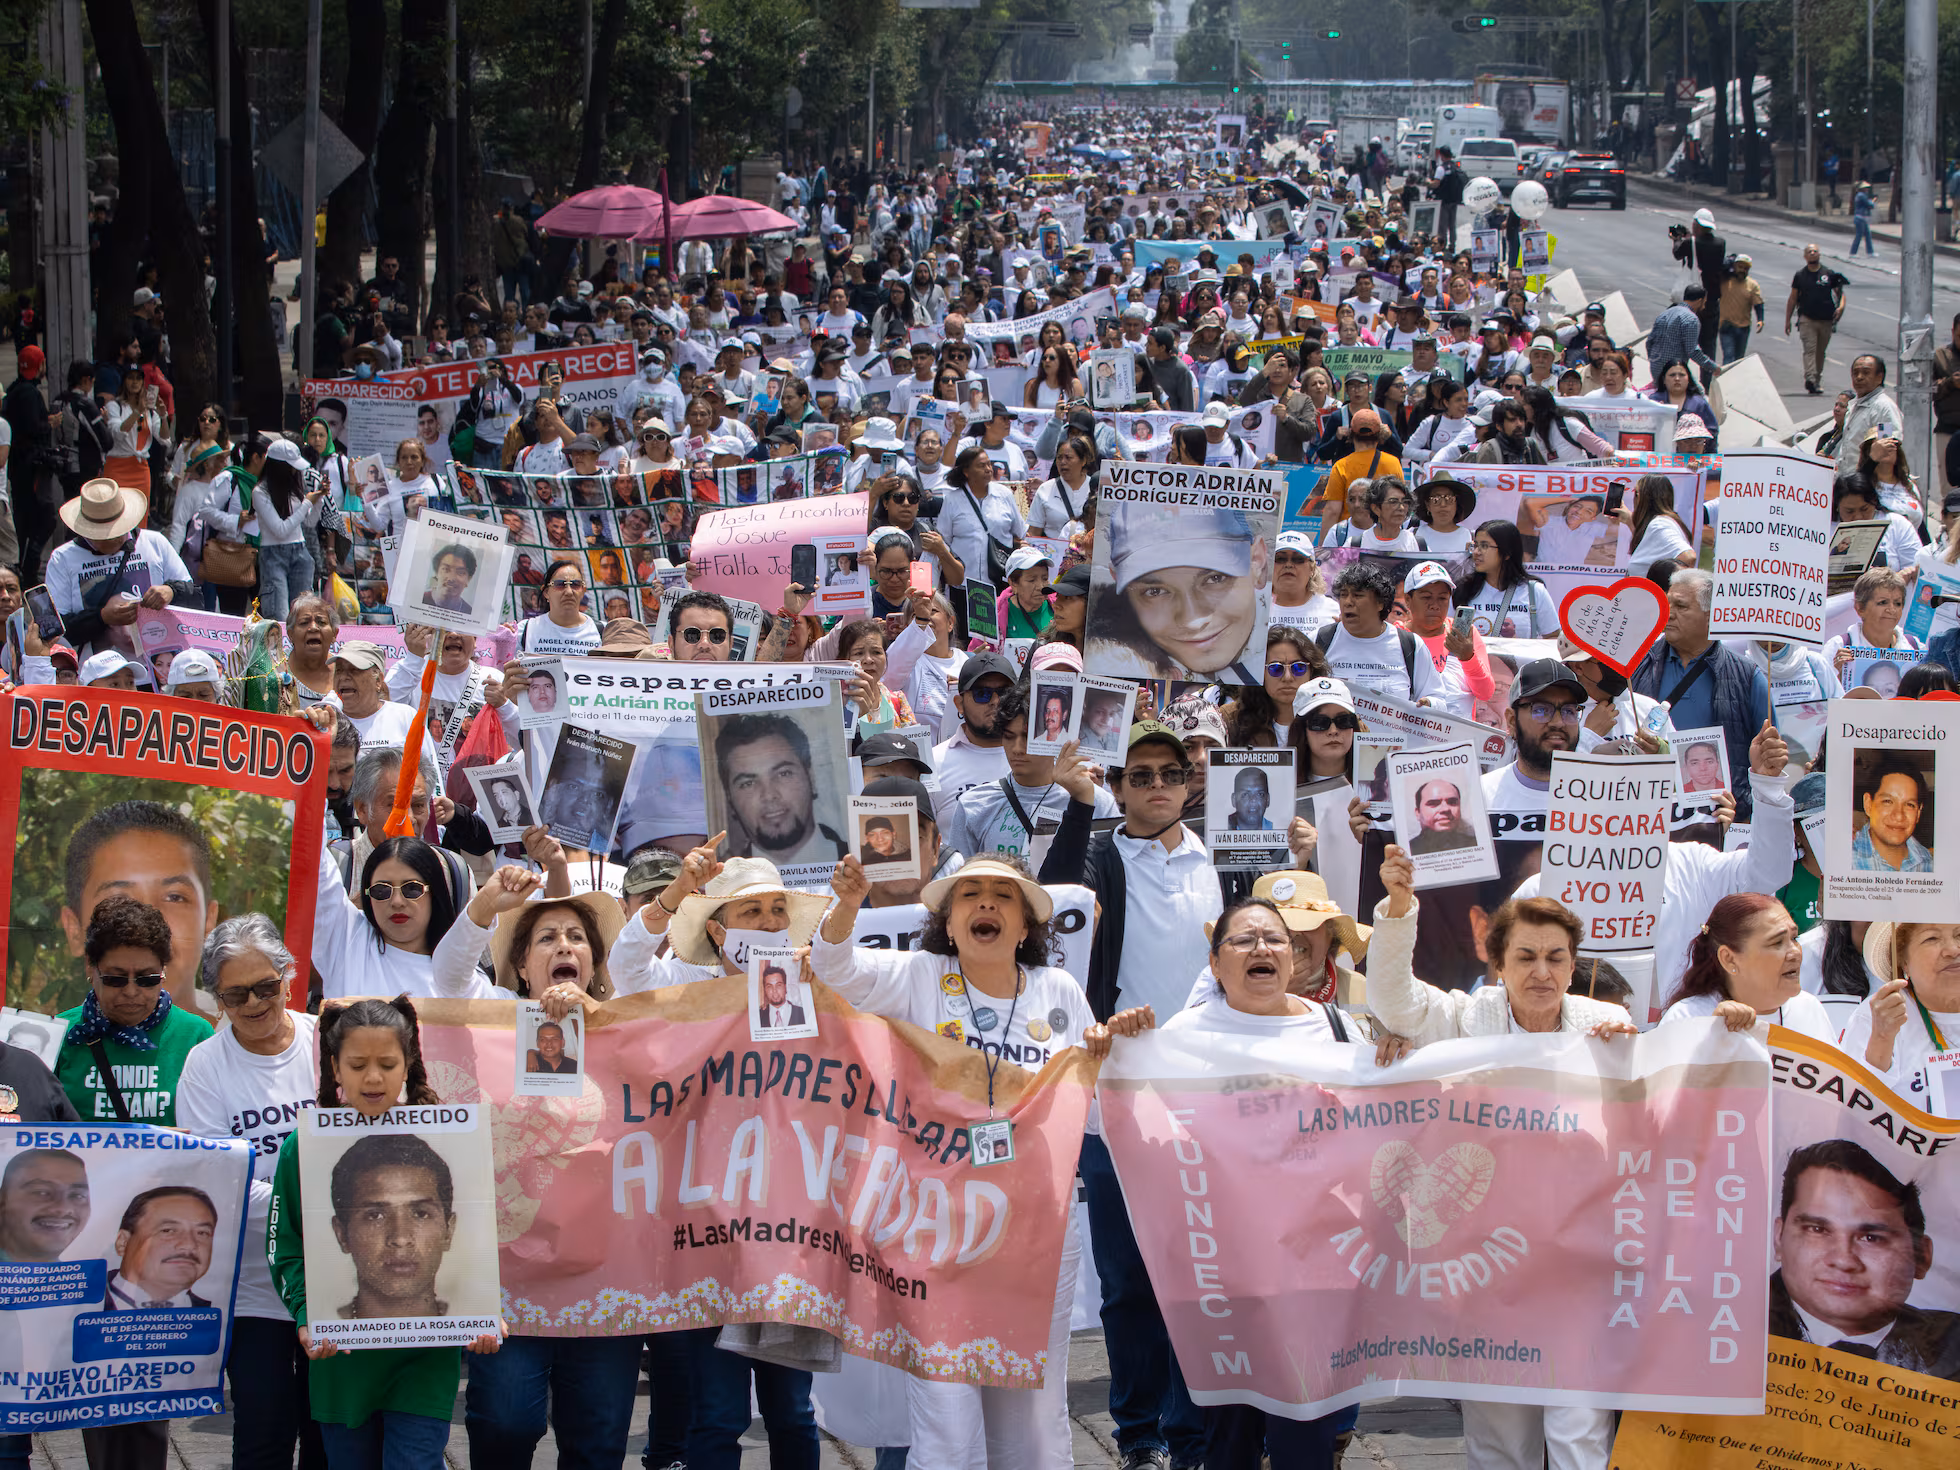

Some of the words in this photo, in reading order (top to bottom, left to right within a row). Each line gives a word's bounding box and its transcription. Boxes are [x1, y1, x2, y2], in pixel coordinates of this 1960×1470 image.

[1335, 354, 1348, 363] DE
[1352, 354, 1383, 363] MAYO
[304, 381, 416, 399] DESAPARECIDO
[432, 373, 463, 391] TE
[1110, 467, 1190, 487] VICTOR
[1193, 474, 1272, 494] ADRIÁN
[1776, 467, 1785, 476] EL
[1497, 474, 1536, 492] SE
[1103, 487, 1199, 507] RODRÍGUEZ
[1202, 494, 1276, 511] MORENO
[1724, 482, 1764, 498] GRAN
[1769, 483, 1828, 509] FRACASO
[710, 514, 765, 528] Hasta
[779, 501, 868, 520] Encontrarte
[1769, 506, 1785, 516] DEL
[428, 518, 499, 542] Desaparecido
[716, 526, 788, 546] Josue
[1721, 521, 1764, 535] ESTADO
[1768, 522, 1826, 545] MEXICANO
[1769, 543, 1779, 552] ES
[78, 567, 111, 580] RAMÍREZ
[82, 559, 106, 570] ÁNGEL
[696, 553, 759, 576] #Falta
[1558, 564, 1590, 572] POMPA
[1717, 558, 1737, 574] NO
[1742, 558, 1824, 584] ENCONTRAR
[1716, 583, 1725, 597] A
[1728, 583, 1796, 601] NUESTROS
[1808, 592, 1822, 607] AS
[1713, 607, 1821, 632] DESAPARECIDOS
[538, 637, 563, 646] ÁNGEL
[565, 639, 599, 648] GERARDO
[1608, 614, 1629, 656] celebrar
[534, 646, 566, 654] RAMÍREZ
[1850, 649, 1877, 658] abriela
[1036, 673, 1074, 683] Desaparecido
[1080, 677, 1135, 691] Desaparecido
[457, 685, 474, 710] LOLA
[593, 694, 659, 709] Adrián
[709, 686, 825, 708] DESAPARECIDO
[639, 714, 667, 723] mayo
[1396, 710, 1442, 732] URGENCIA
[9, 696, 315, 785] DESAPARECIDO
[441, 716, 461, 749] BIMBA
[572, 728, 623, 749] DESAPARECIDO
[1357, 735, 1405, 743] Desaparecido
[1672, 734, 1721, 744] DESAPARECIDO
[1841, 723, 1947, 743] Desaparecido
[567, 738, 579, 747] Iván
[580, 743, 602, 755] Baruch
[603, 749, 622, 760] Núñez
[1224, 752, 1279, 764] DESAPARECIDO
[1395, 754, 1469, 775] DESAPARECIDO
[1553, 776, 1641, 801] ¿QUIÉN
[1648, 780, 1671, 800] TE
[1550, 807, 1666, 837] BUSCARÁ
[1216, 833, 1231, 843] IVÁN
[1234, 834, 1260, 843] BARUCH
[1263, 832, 1285, 842] NÚÑEZ
[1547, 844, 1662, 871] CUANDO
[780, 865, 807, 876] DAVILA
[1829, 875, 1844, 883] José
[1846, 876, 1873, 884] Antonio
[1874, 877, 1904, 885] Robledo
[1906, 877, 1944, 886] Fernández
[1561, 880, 1610, 904] ¿YO
[1618, 881, 1644, 903] YA
[1829, 885, 1863, 893] Desaparecido
[1591, 910, 1656, 939] ESTÉ?
[1938, 1054, 1953, 1062] HIJO
[622, 1074, 696, 1124] LAS
[701, 1050, 862, 1109] MADRES
[317, 1108, 469, 1128] DESAPARECIDO
[1298, 1108, 1338, 1134] LAS
[1343, 1098, 1440, 1130] MADRES
[1449, 1099, 1580, 1134] LLEGARÁN
[16, 1130, 233, 1150] DESAPARECIDOS
[612, 1130, 664, 1220] A
[678, 1115, 770, 1205] LA
[791, 1120, 1013, 1269] VERDAD
[1665, 1158, 1696, 1217] DE
[268, 1195, 281, 1266] EDSON
[1608, 1150, 1651, 1330] MARCHA
[1708, 1109, 1746, 1364] DIGNIDAD
[33, 1264, 81, 1274] EDUARDO
[1330, 1225, 1364, 1256] A
[1347, 1243, 1390, 1291] LA
[1395, 1225, 1530, 1300] VERDAD
[48, 1272, 87, 1283] RANGEL
[1657, 1254, 1694, 1314] LA
[8, 1283, 75, 1294] DESAPARECIDO
[12, 1294, 37, 1304] JULIO
[61, 1291, 84, 1301] 2018
[79, 1316, 134, 1327] FRANCISCO
[135, 1314, 174, 1323] RANGEL
[176, 1313, 217, 1322] VARGAS
[120, 1323, 193, 1332] DESAPARECIDO
[315, 1325, 349, 1334] EDSON
[352, 1322, 396, 1333] AMADEO
[430, 1320, 456, 1329] ROSA
[458, 1319, 495, 1329] GARCIA
[117, 1334, 129, 1342] 27
[144, 1332, 187, 1340] FEBRERO
[146, 1343, 166, 1351] 2011
[394, 1336, 416, 1344] JULIO
[437, 1333, 474, 1342] TORREÓN
[1330, 1335, 1542, 1371] #LasMadresNoSeRinden
[26, 1366, 100, 1387] NUEVO
[106, 1361, 195, 1378] LAREDO
[1768, 1351, 1807, 1370] onio
[1812, 1356, 1869, 1387] Mena
[21, 1376, 162, 1401] TAMAULIPAS
[1766, 1381, 1809, 1400] esde:
[1814, 1388, 1836, 1404] 29
[1868, 1402, 1919, 1428] Junio
[7, 1405, 104, 1425] SEGUIMOS
[1828, 1414, 1912, 1448] Coahuila
[1655, 1423, 1676, 1438] No
[1679, 1429, 1715, 1443] Esperes
[1719, 1435, 1747, 1450] Que
[1766, 1445, 1832, 1468] Olvidemos
